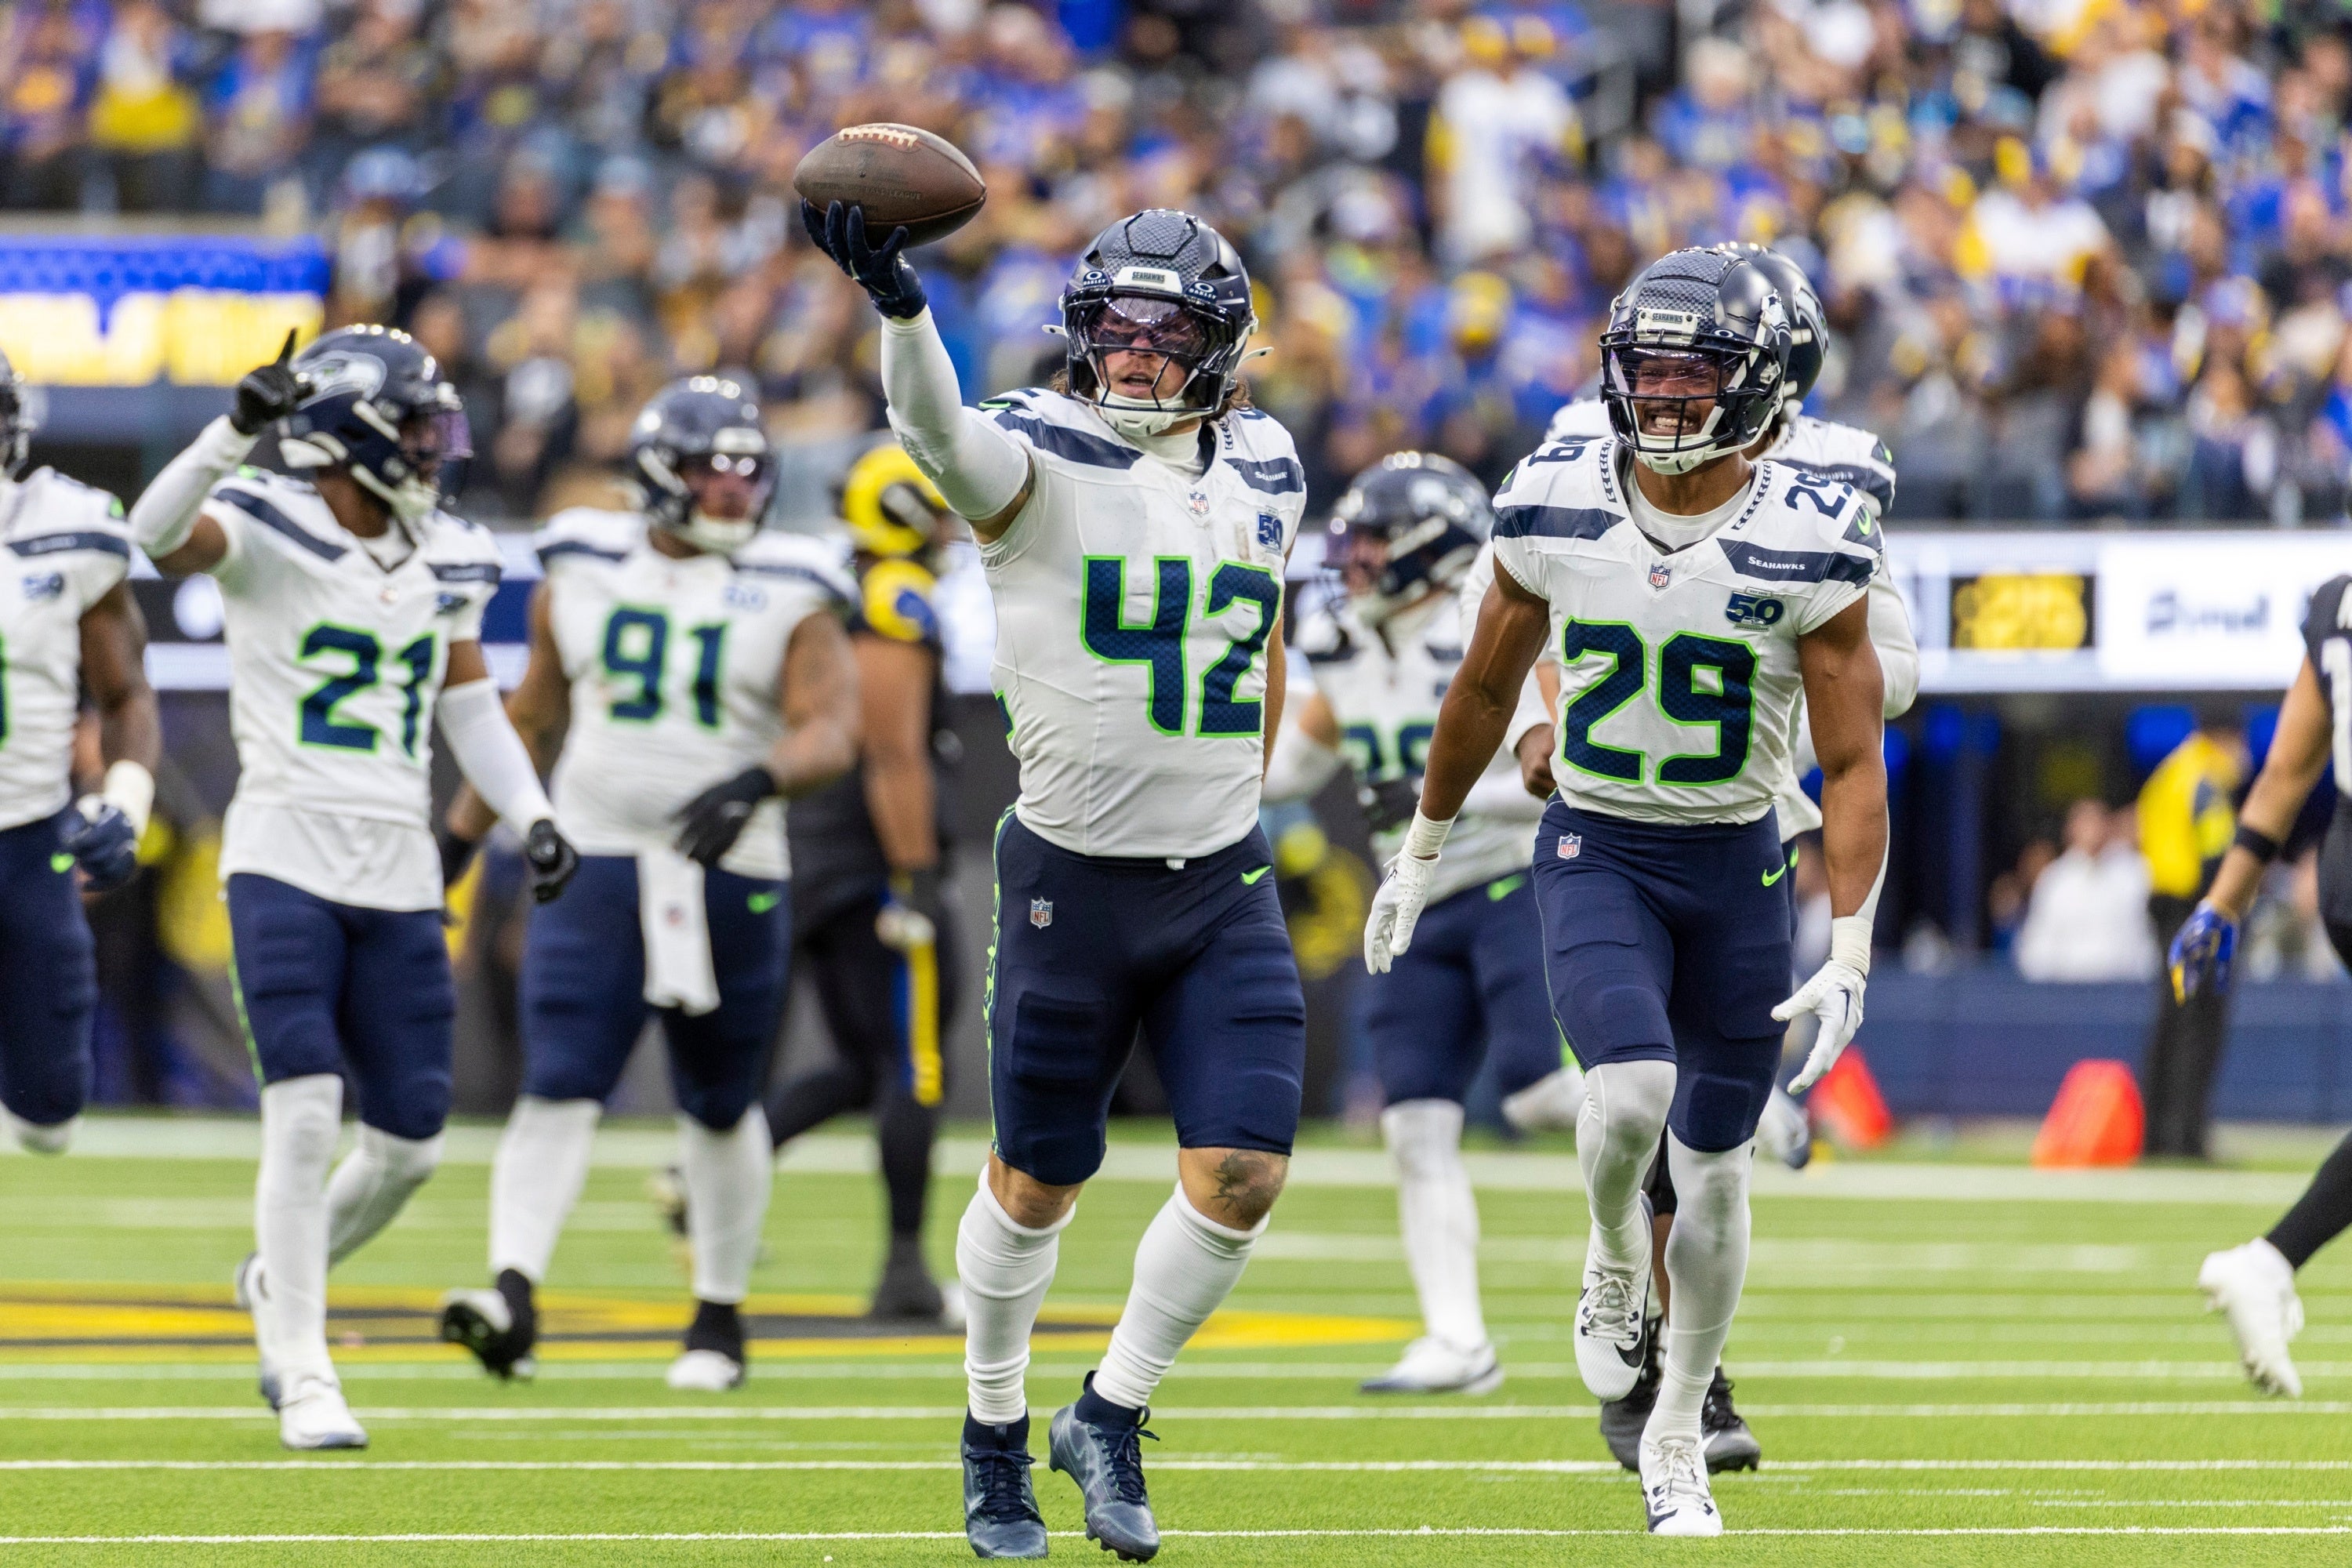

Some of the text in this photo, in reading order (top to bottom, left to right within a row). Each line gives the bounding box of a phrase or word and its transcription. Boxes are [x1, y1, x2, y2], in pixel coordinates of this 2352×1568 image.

[1131, 271, 1166, 283] SEAHAWKS
[1189, 288, 1218, 299] OAKLEY
[1652, 313, 1683, 323] SEAHAWKS
[1192, 500, 1208, 510] NFL
[1258, 512, 1283, 549] 50
[1748, 556, 1806, 571] SEAHAWKS
[1651, 573, 1667, 586] NFL
[1726, 590, 1784, 626] 50
[1080, 555, 1282, 738] 42
[602, 602, 731, 734] 91
[296, 620, 438, 763] 21
[1562, 615, 1759, 788] 29
[1561, 844, 1577, 855] NFL
[1034, 911, 1049, 923] NFL
